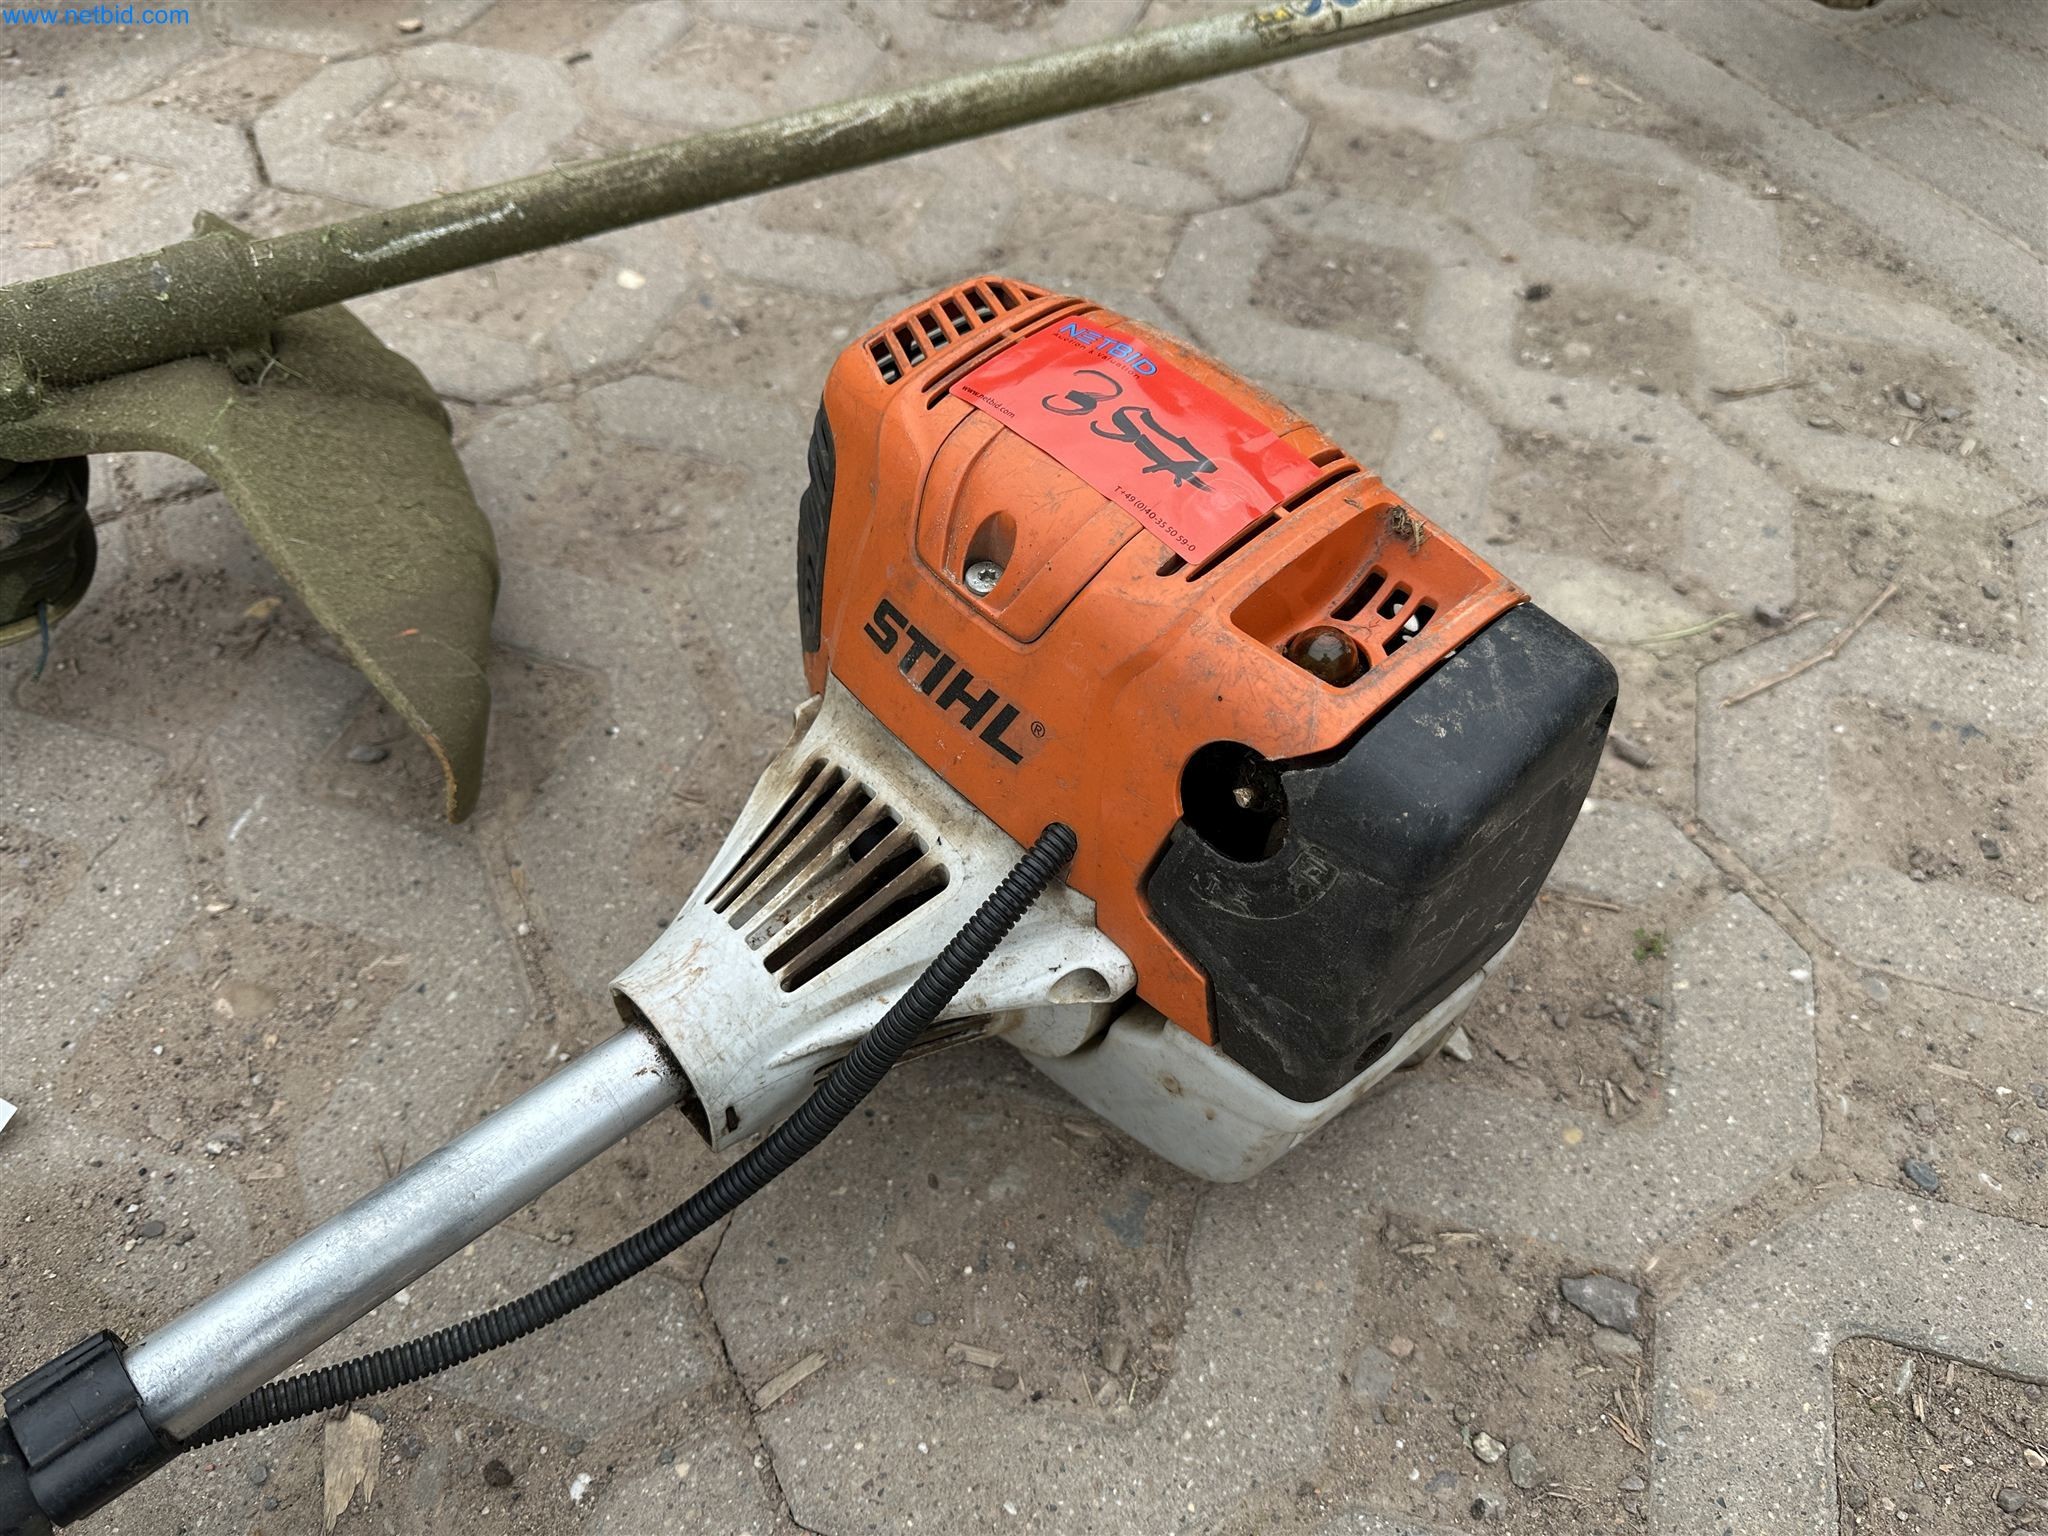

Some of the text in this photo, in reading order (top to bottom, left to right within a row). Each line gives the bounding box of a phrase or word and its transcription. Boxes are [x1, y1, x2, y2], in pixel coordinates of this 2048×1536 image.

[1052, 332, 1086, 350] Auction
[1097, 353, 1141, 380] Valuation
[1059, 322, 1157, 376] NETBID
[962, 385, 1015, 418] www.netbid.com
[1041, 369, 1219, 492] 357
[1121, 489, 1136, 502] +49
[1133, 500, 1167, 528] (0)40-35
[1165, 526, 1178, 537] 50
[1176, 535, 1196, 552] 59-0
[863, 598, 1023, 766] STIHL
